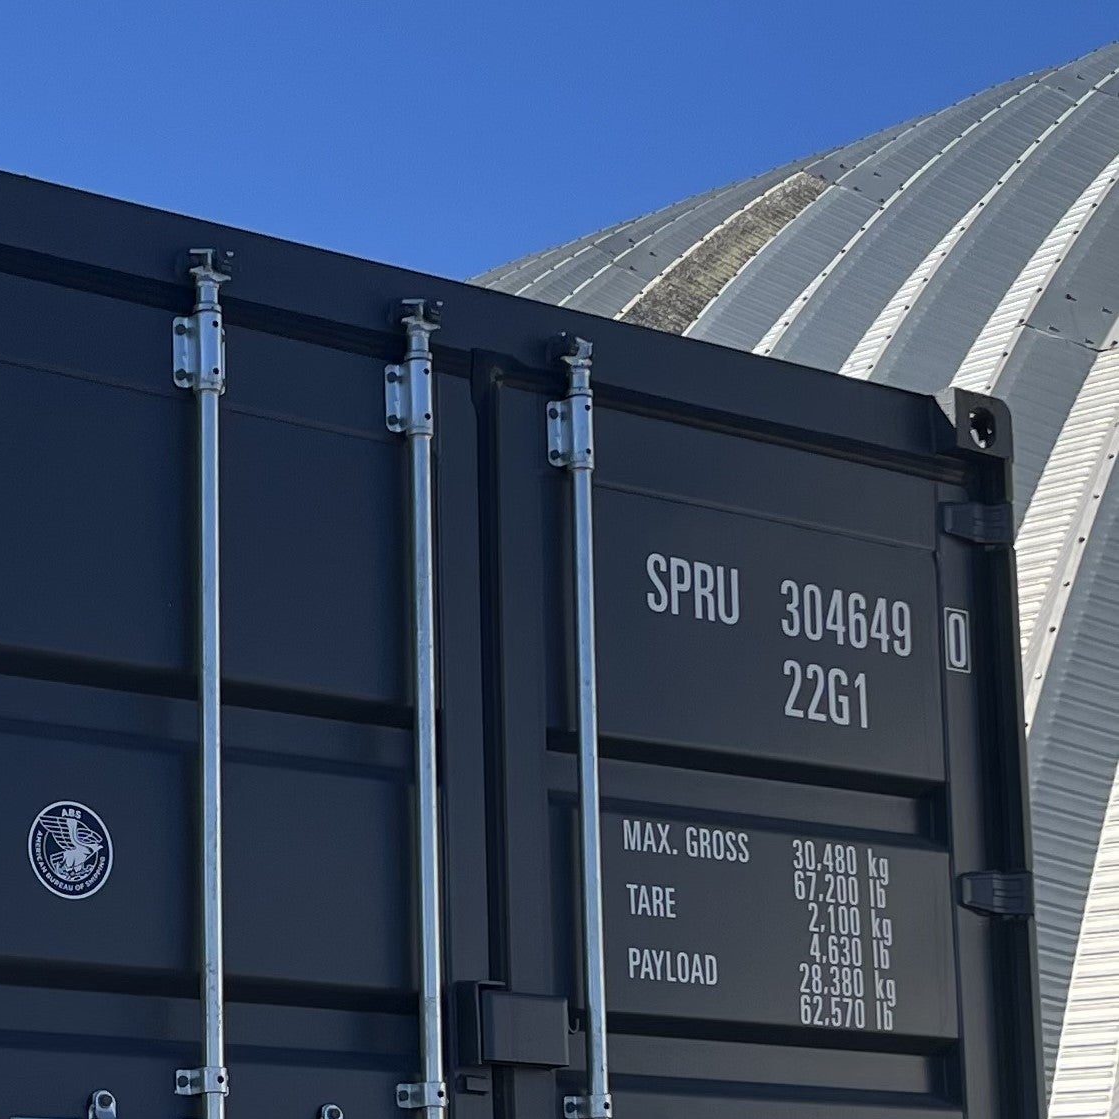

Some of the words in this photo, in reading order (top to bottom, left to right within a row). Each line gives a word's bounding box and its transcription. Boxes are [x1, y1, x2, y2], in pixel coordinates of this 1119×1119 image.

[646, 552, 741, 626] SPRU
[781, 579, 913, 658] 304649
[783, 659, 869, 729] 22G1
[61, 808, 82, 820] ABS
[34, 829, 47, 874] AMERICAN
[45, 872, 74, 892] BUREAU
[74, 883, 86, 891] OF
[85, 856, 107, 889] SHIPPING
[622, 819, 678, 856] MAX.
[685, 826, 751, 864] GROSS
[792, 840, 858, 877] 30,480
[867, 849, 890, 885] kg
[626, 884, 677, 919] TARE
[807, 903, 861, 936] 2,100
[870, 909, 893, 946] kg
[793, 871, 859, 906] 67,200
[869, 879, 887, 909] lb
[628, 947, 719, 986] PAYLOAD
[799, 963, 865, 998] 28,380
[874, 970, 897, 1007] kg
[809, 933, 863, 968] 4,630
[872, 940, 891, 970] lb
[800, 995, 866, 1030] 62,570
[876, 1001, 894, 1031] lb
